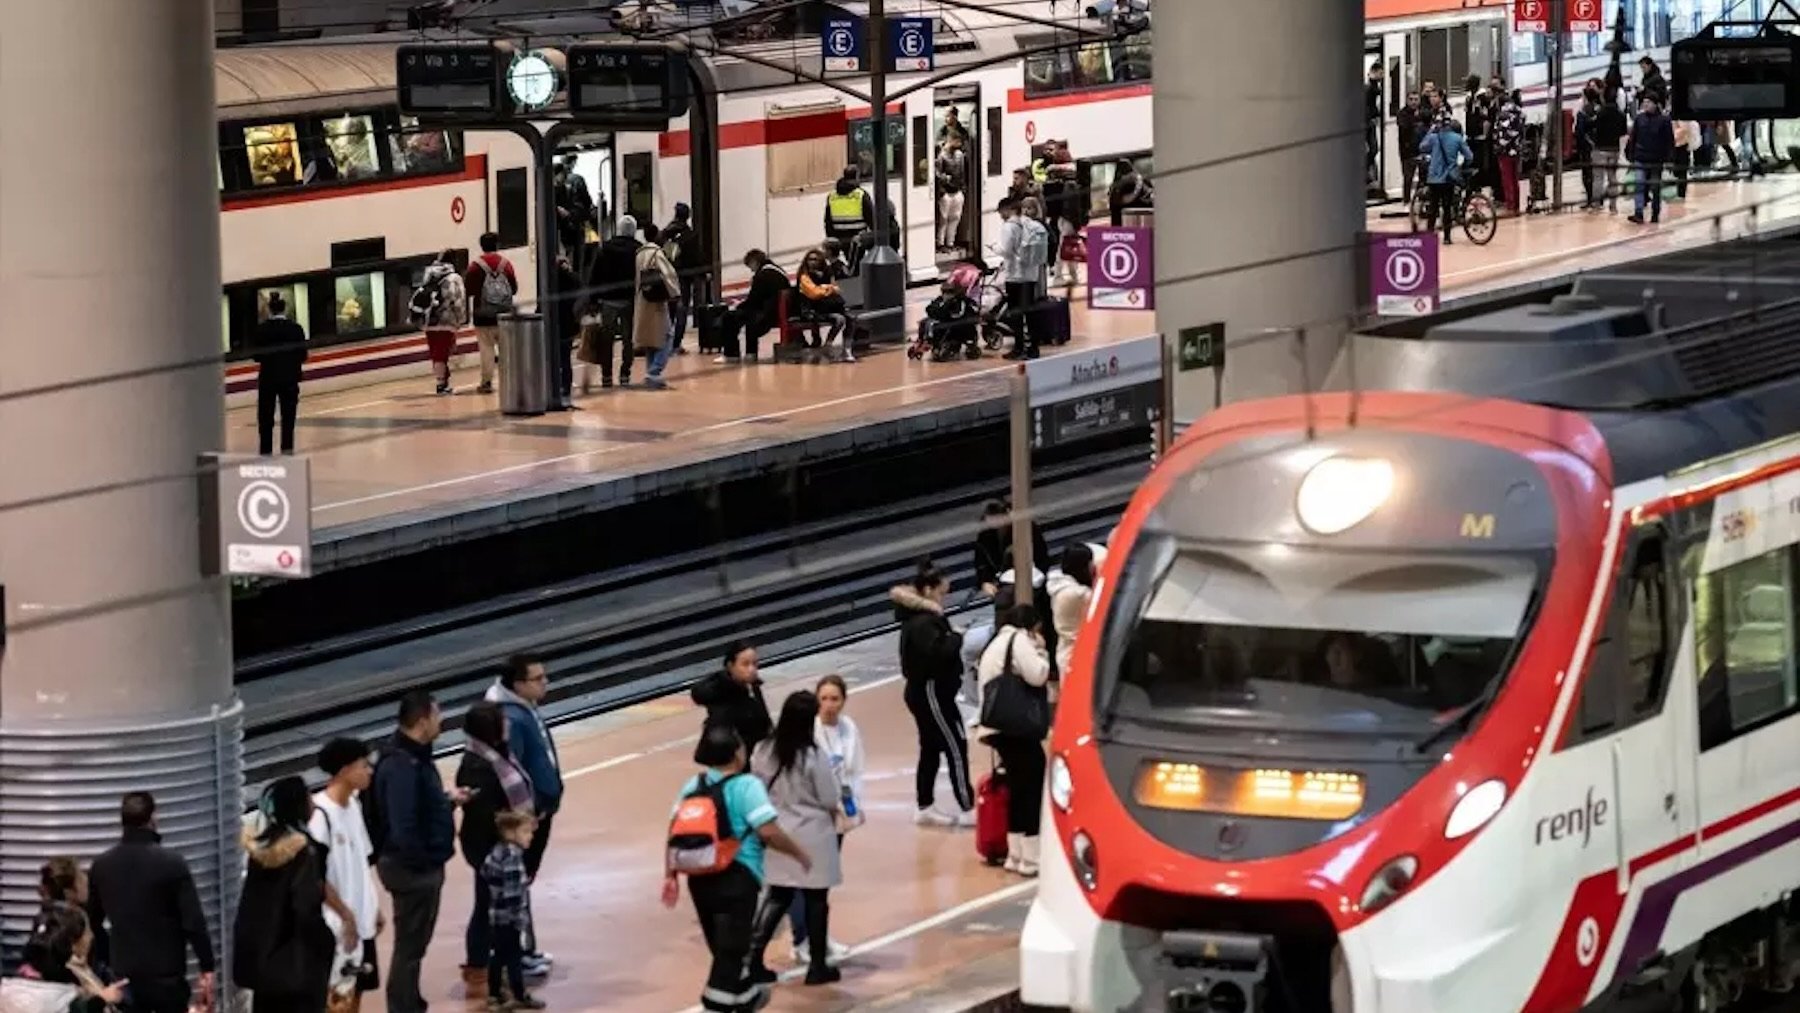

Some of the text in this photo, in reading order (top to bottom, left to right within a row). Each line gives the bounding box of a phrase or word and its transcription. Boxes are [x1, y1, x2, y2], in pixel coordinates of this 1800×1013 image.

[1526, 2, 1536, 17] F
[1579, 2, 1589, 17] F
[835, 33, 847, 52] E
[906, 34, 918, 53] E
[449, 54, 459, 66] 3
[619, 54, 628, 66] 4
[1101, 232, 1136, 241] SECTOR
[1386, 238, 1423, 248] SECTOR
[1109, 248, 1132, 277] D
[1395, 256, 1418, 284] D
[238, 465, 287, 478] SECTOR
[247, 488, 280, 529] C
[1459, 512, 1496, 538] M
[1535, 785, 1608, 849] renfe
